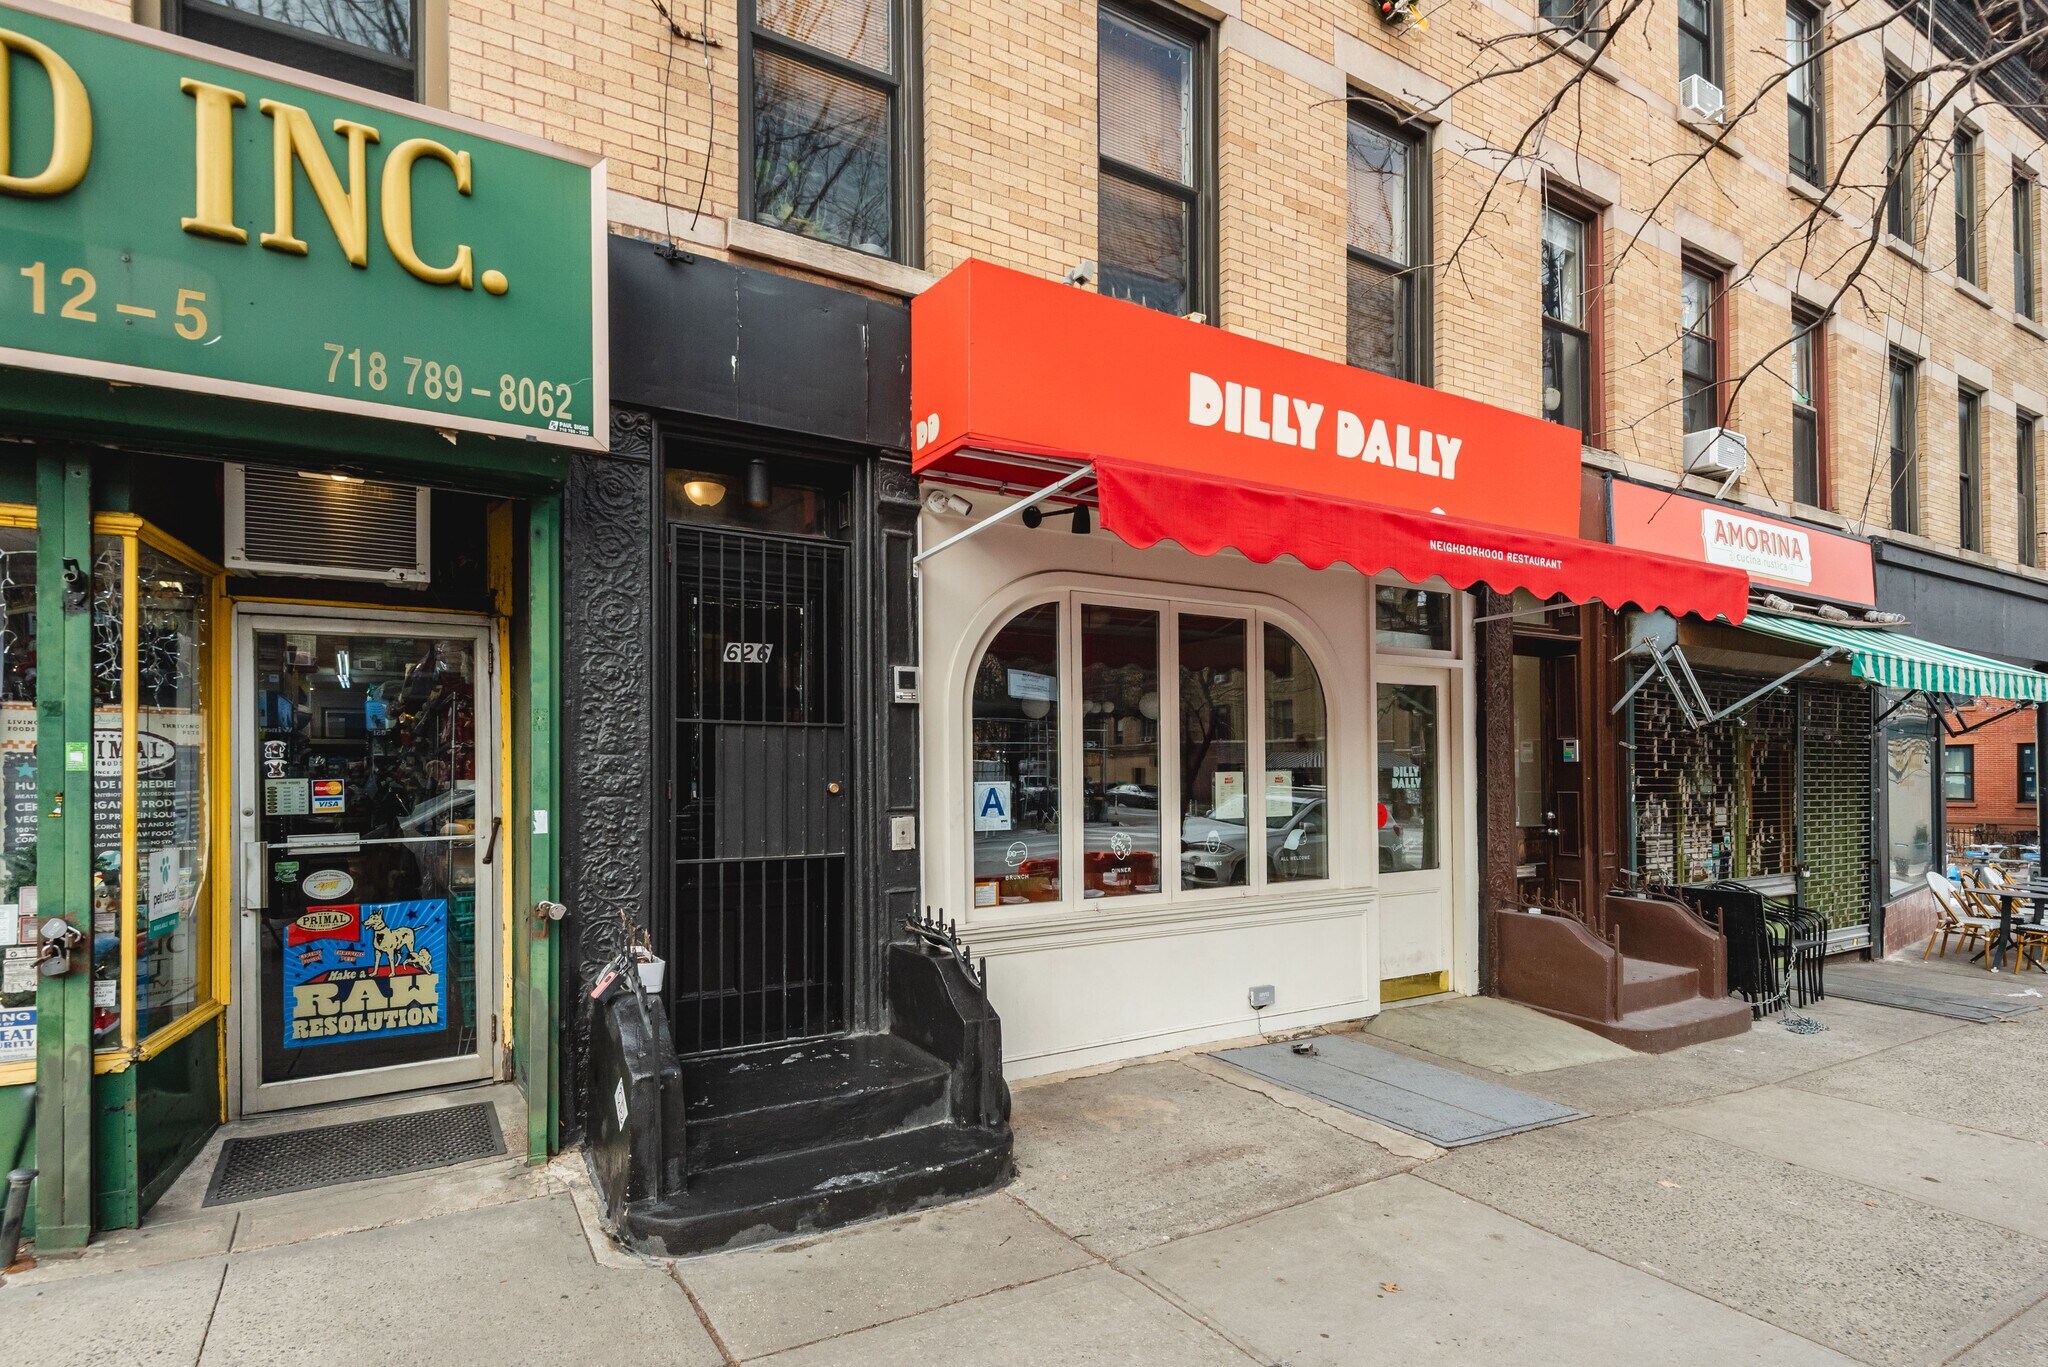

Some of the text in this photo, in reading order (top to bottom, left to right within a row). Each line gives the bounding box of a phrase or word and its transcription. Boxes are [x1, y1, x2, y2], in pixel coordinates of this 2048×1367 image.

[180, 77, 509, 296] INC.
[324, 342, 388, 391] 718
[916, 412, 940, 451] DD
[1189, 372, 1463, 480] DILLY DALLY
[1714, 519, 1804, 562] AMORINA
[1429, 539, 1563, 570] NEIGHBORHOOD RESTAURANT
[1736, 553, 1788, 572] cucina rustica
[726, 644, 770, 661] 626
[1393, 766, 1420, 778] DILLY
[15, 781, 38, 791] HU
[95, 780, 117, 789] ADE
[1391, 777, 1422, 789] DALLY
[319, 800, 339, 808] VISA
[980, 787, 1005, 817] A
[15, 815, 38, 823] VEG
[1005, 873, 1030, 881] BRUNCH
[1111, 866, 1132, 874] DINNER
[303, 914, 347, 926] PRIMAL
[328, 970, 357, 981] Make
[293, 973, 440, 1019] RAW
[1, 1011, 31, 1022] NG
[292, 1005, 439, 1039] RESOLUTION
[0, 1027, 35, 1042] EAT
